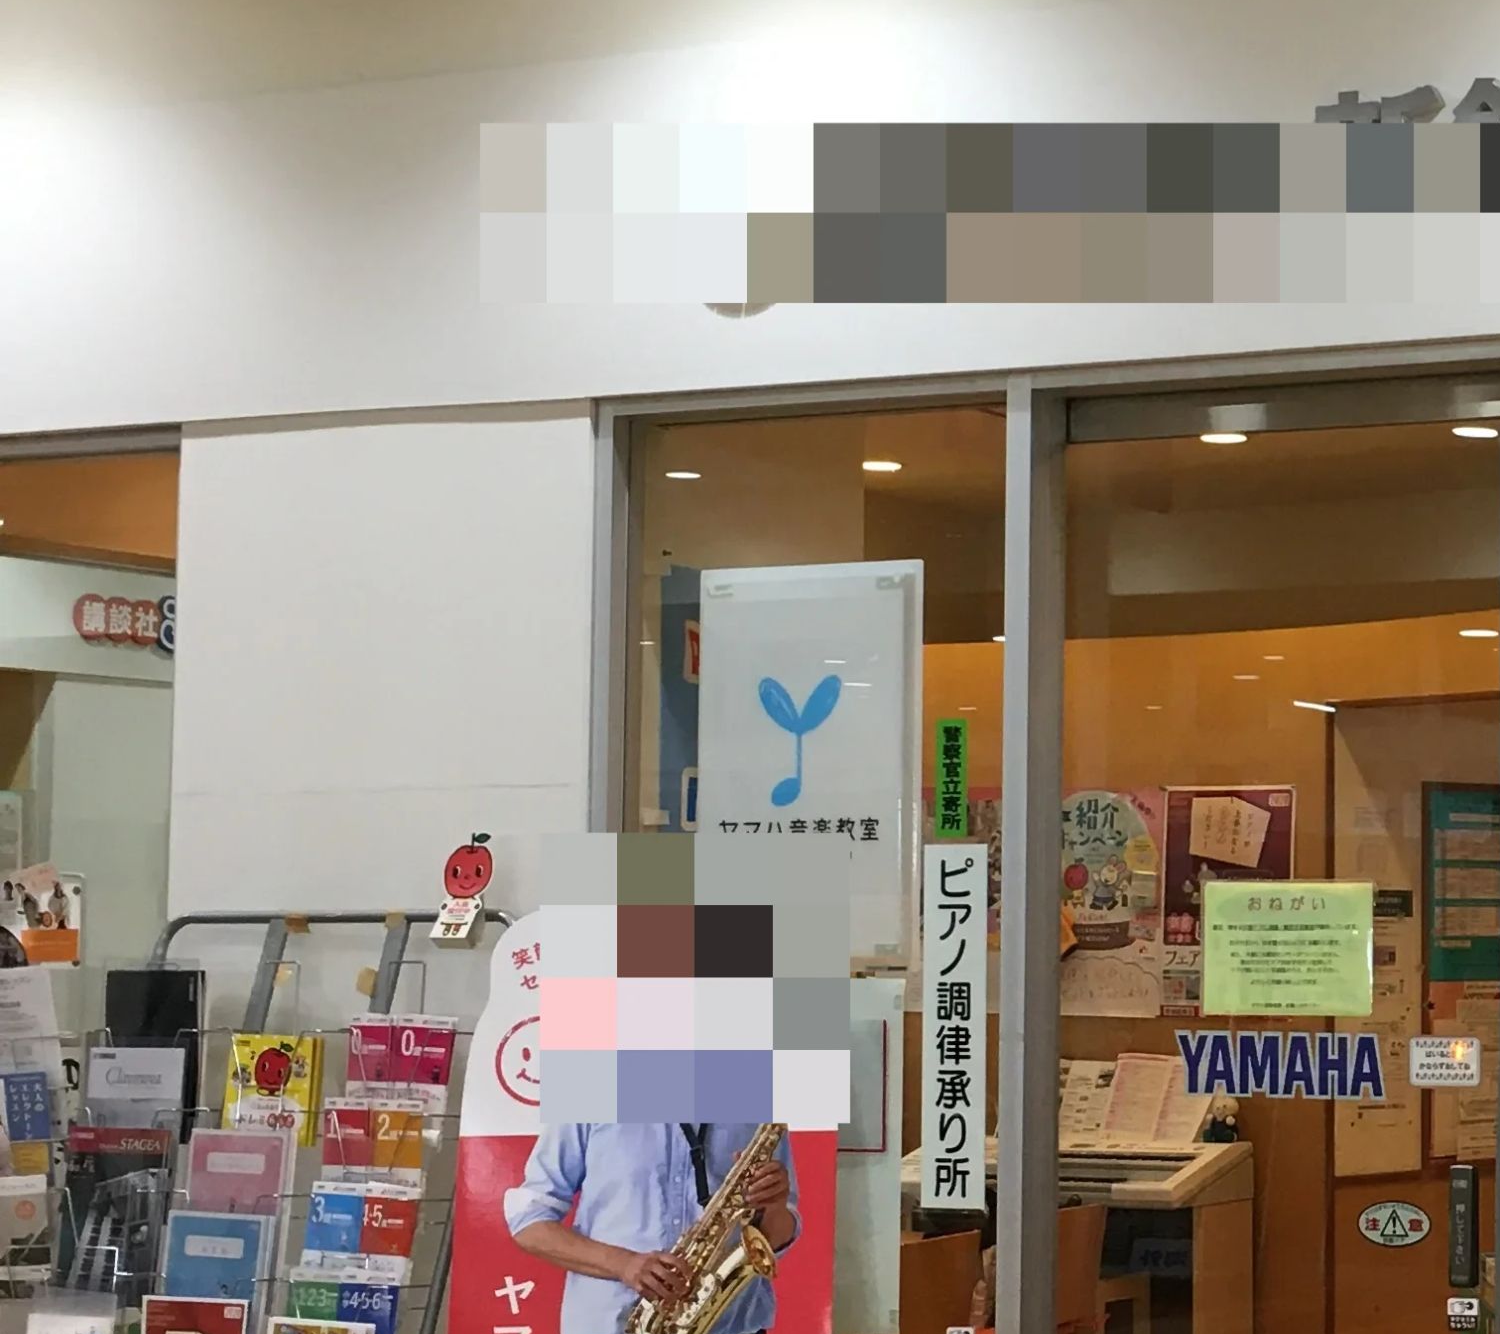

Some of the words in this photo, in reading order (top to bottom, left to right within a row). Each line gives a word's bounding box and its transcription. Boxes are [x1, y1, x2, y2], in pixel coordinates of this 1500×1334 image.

[82, 600, 158, 638] 講談社
[941, 725, 962, 830] 警察官立寄所
[1246, 895, 1326, 911] おねがい
[934, 858, 973, 1199] ピアノ調律承り所
[1176, 1031, 1386, 1099] YAMAHA
